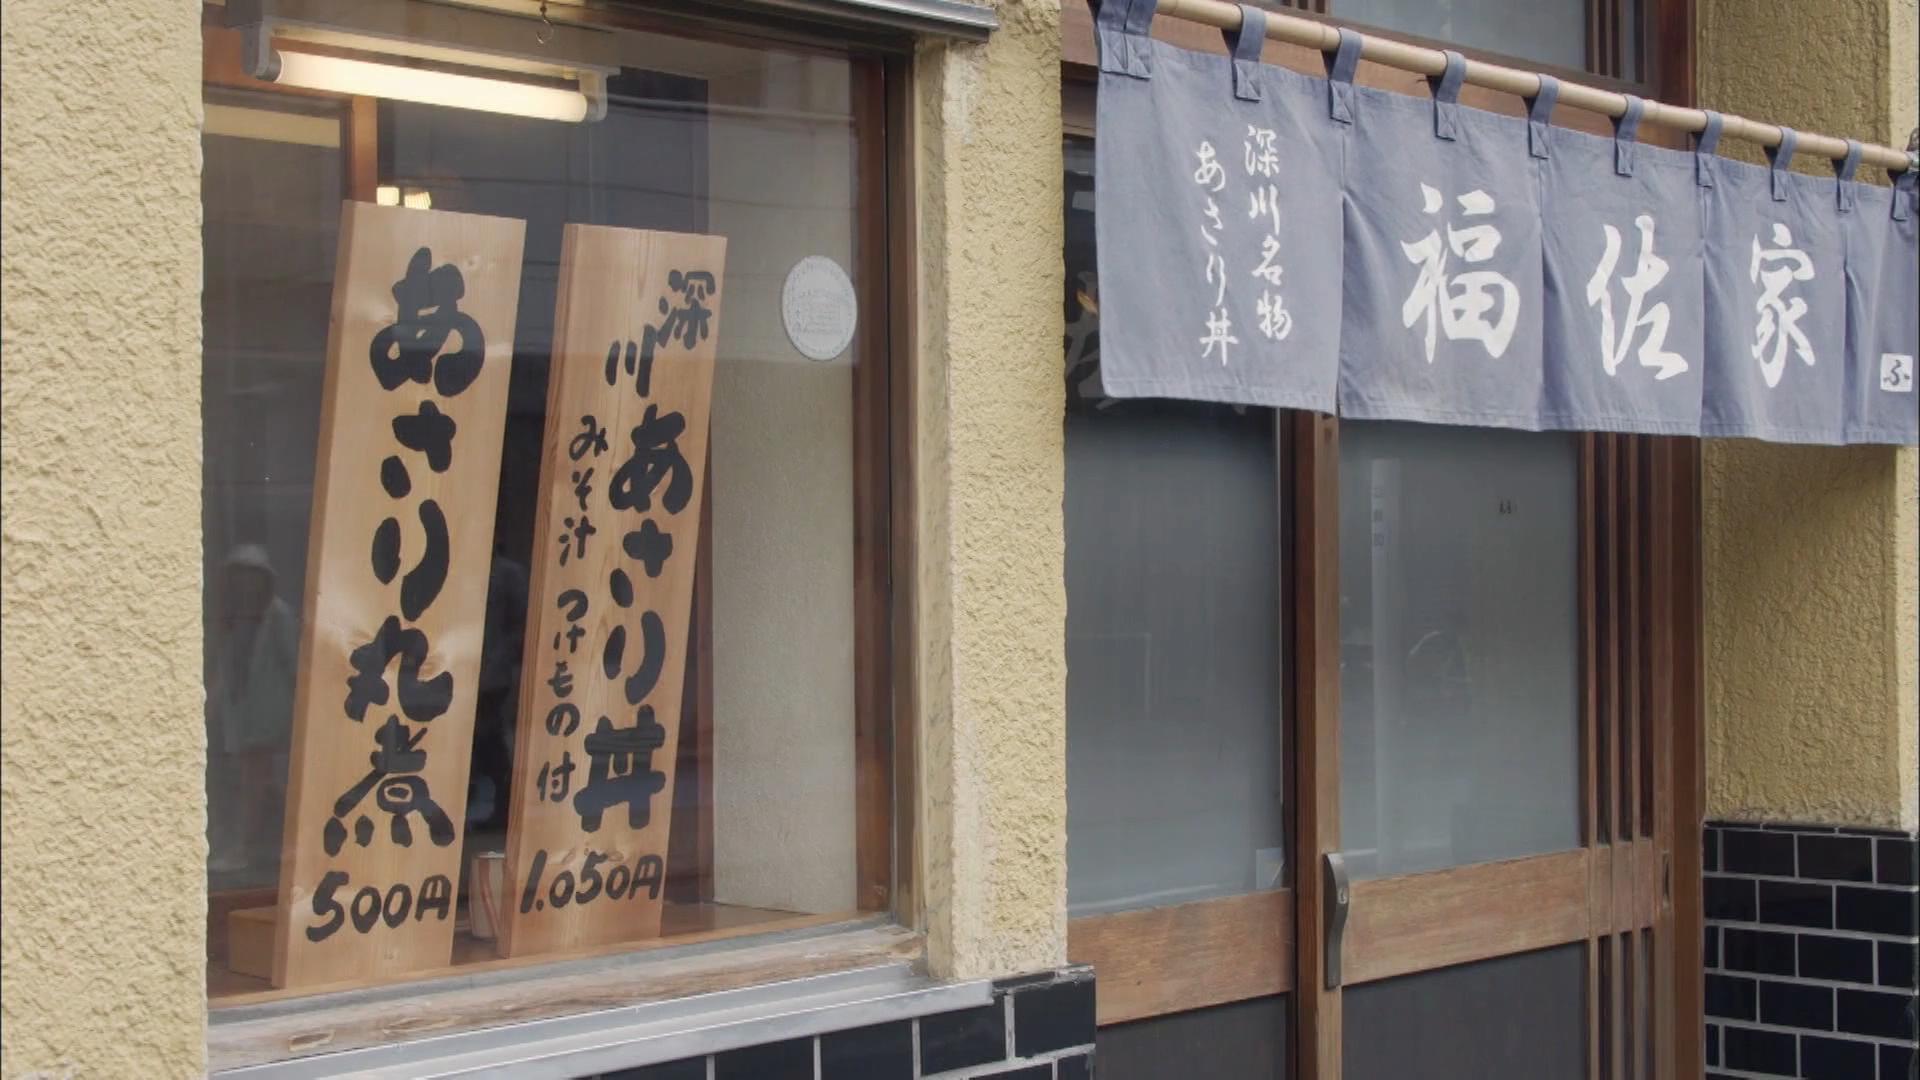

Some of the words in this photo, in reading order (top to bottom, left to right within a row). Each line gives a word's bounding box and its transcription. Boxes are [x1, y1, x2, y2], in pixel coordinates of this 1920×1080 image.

[1193, 140, 1240, 367] あさり丼
[1244, 124, 1293, 341] 深川名物
[1401, 183, 1816, 389] 福佐家
[324, 247, 485, 856] あさり丸煮
[307, 871, 452, 943] 500円
